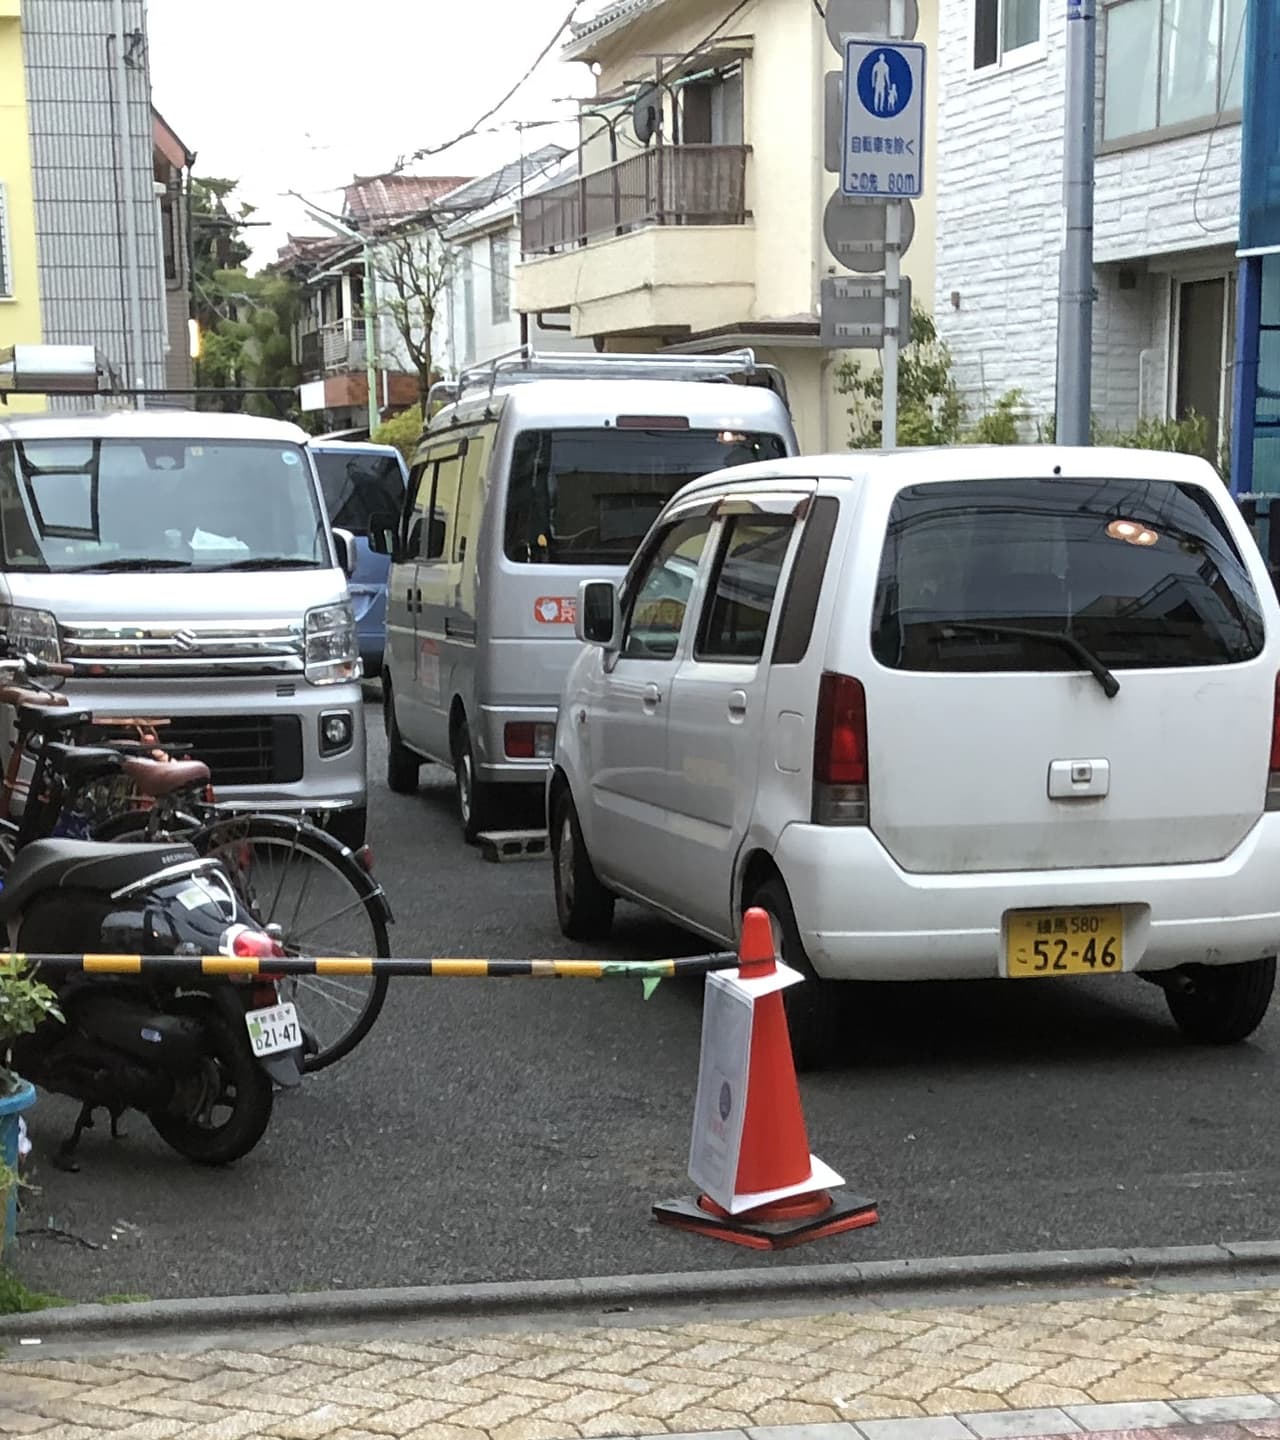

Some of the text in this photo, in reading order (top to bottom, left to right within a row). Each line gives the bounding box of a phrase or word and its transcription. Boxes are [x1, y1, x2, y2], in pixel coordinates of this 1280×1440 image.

[851, 136, 915, 155] 自転車を除く
[888, 172, 915, 193] 80m
[1037, 916, 1099, 935] 練馬 580
[1033, 936, 1117, 971] 52-46
